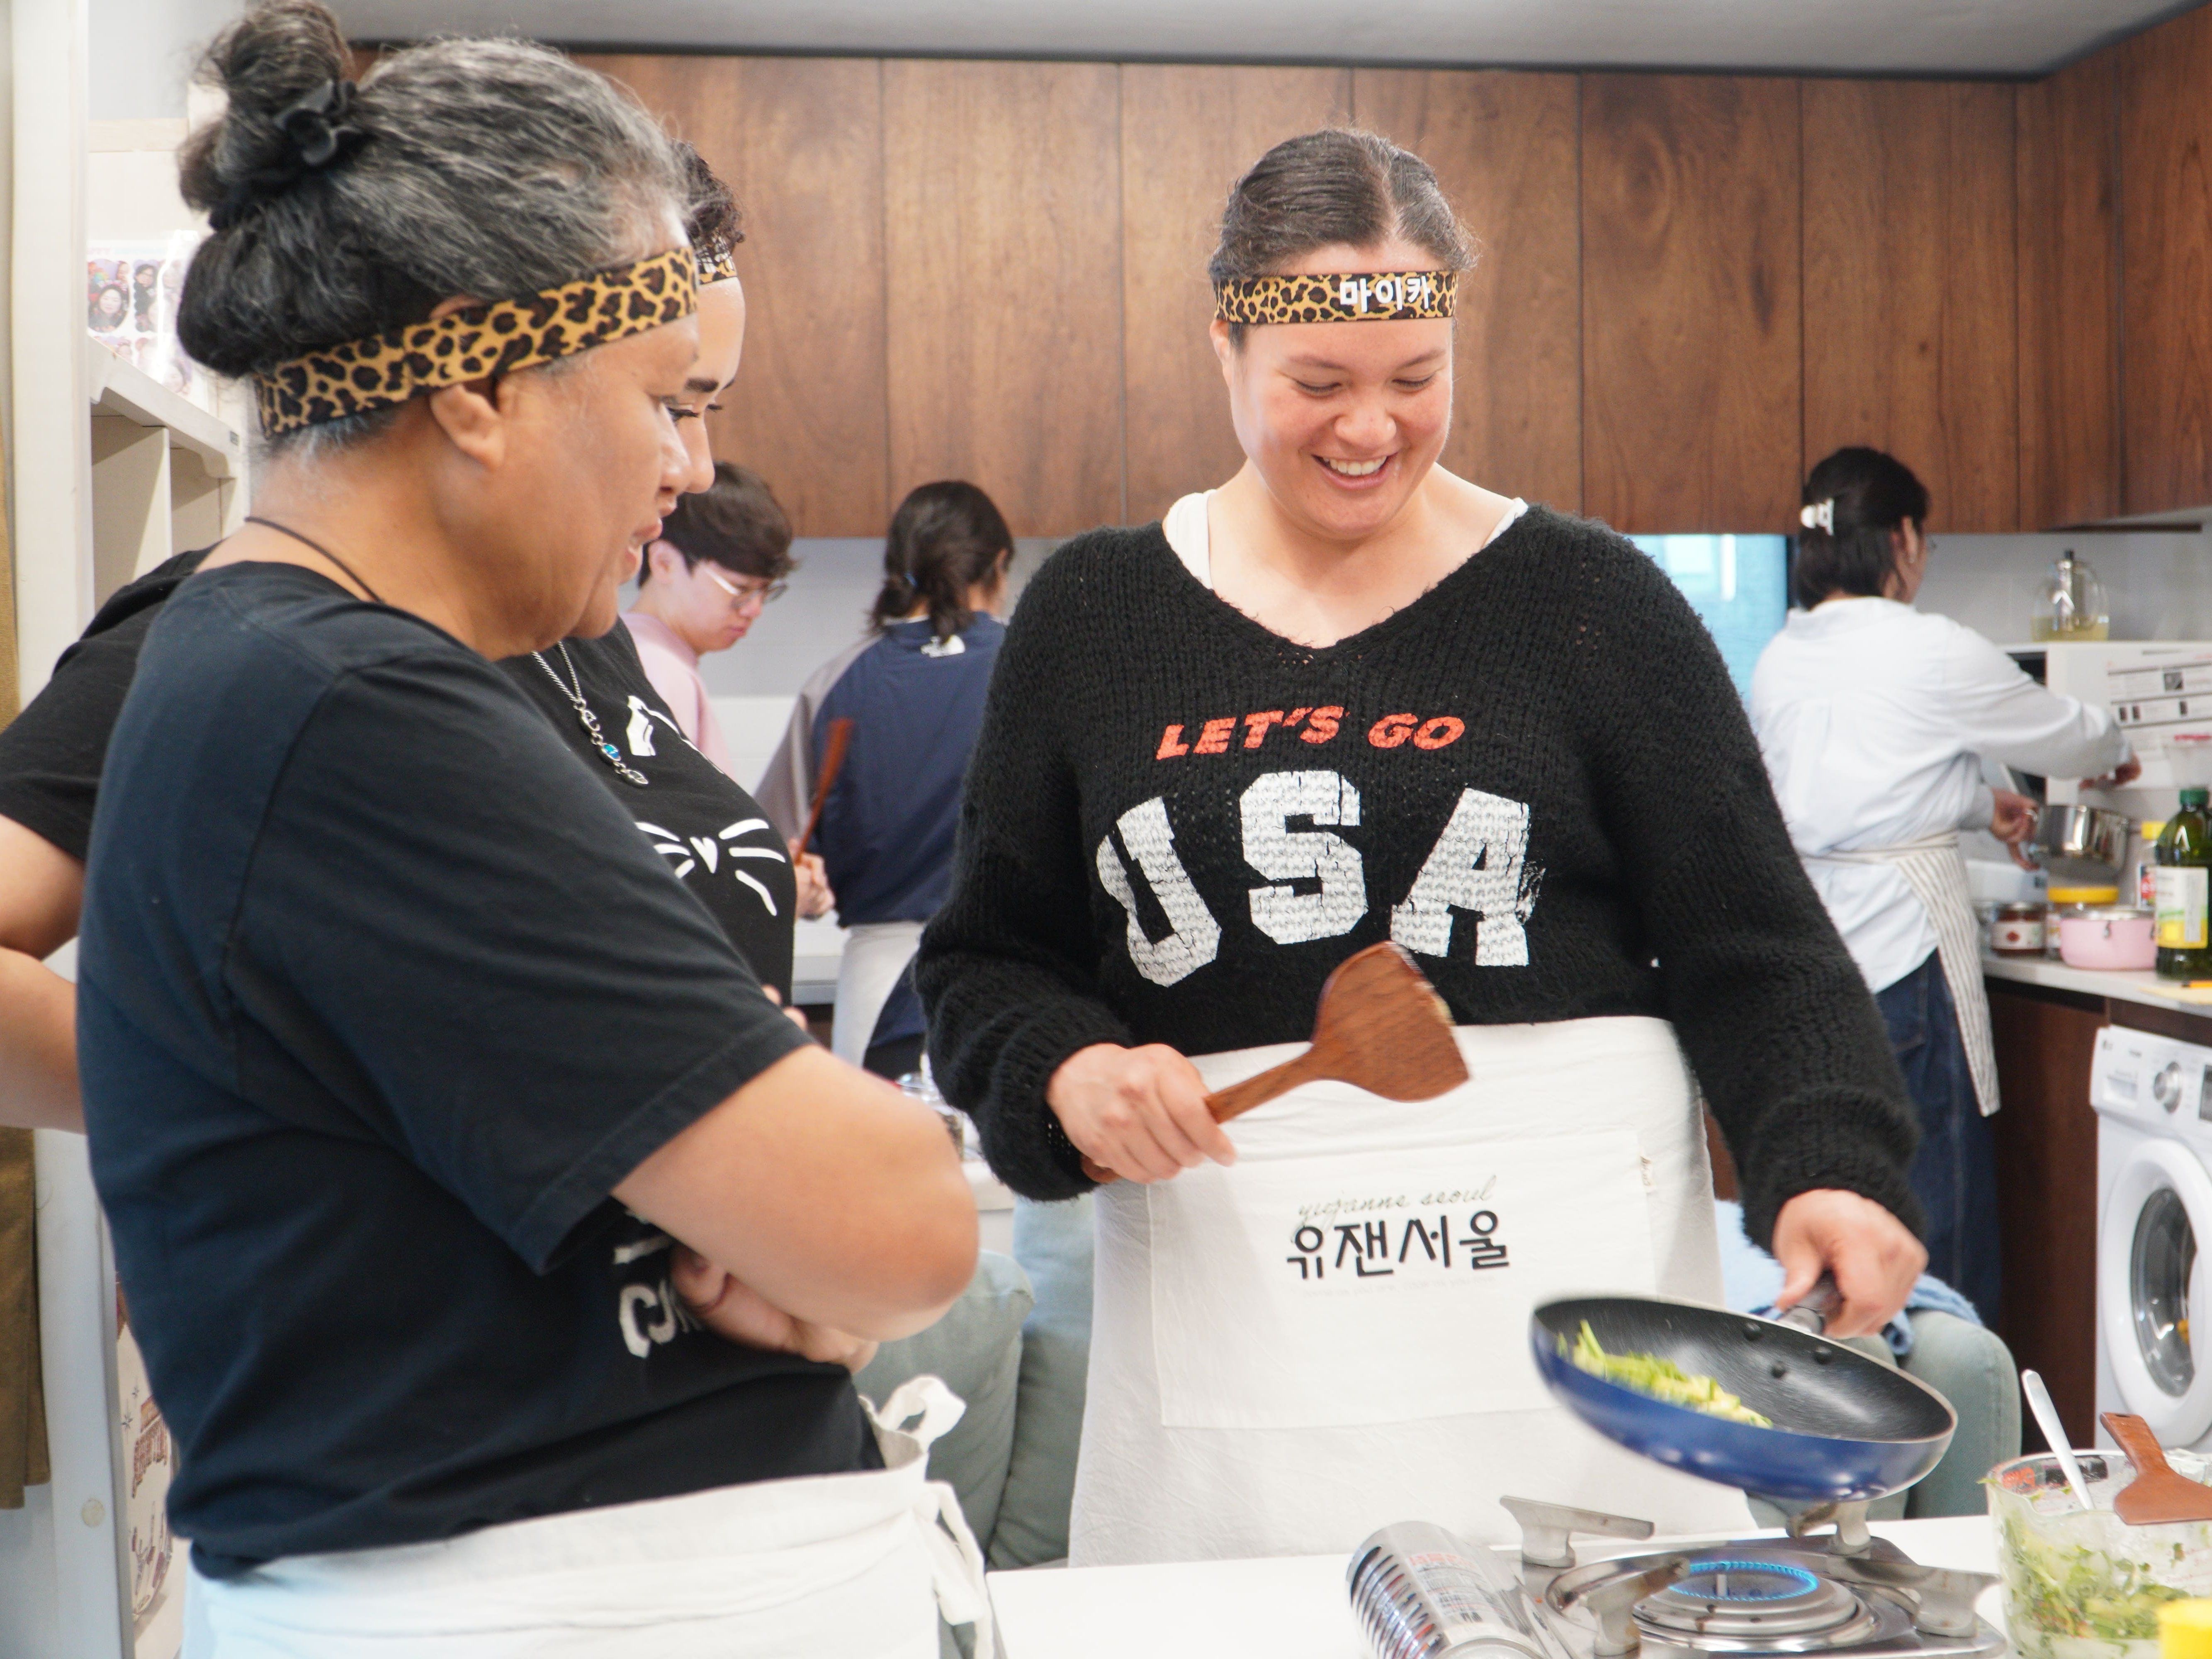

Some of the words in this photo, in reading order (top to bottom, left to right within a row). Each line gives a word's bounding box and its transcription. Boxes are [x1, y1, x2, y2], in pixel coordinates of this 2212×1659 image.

[1340, 277, 1430, 313] 마이카
[1368, 713, 1466, 750] GO
[1096, 770, 1546, 987] USA
[1421, 1175, 1497, 1206] seoul
